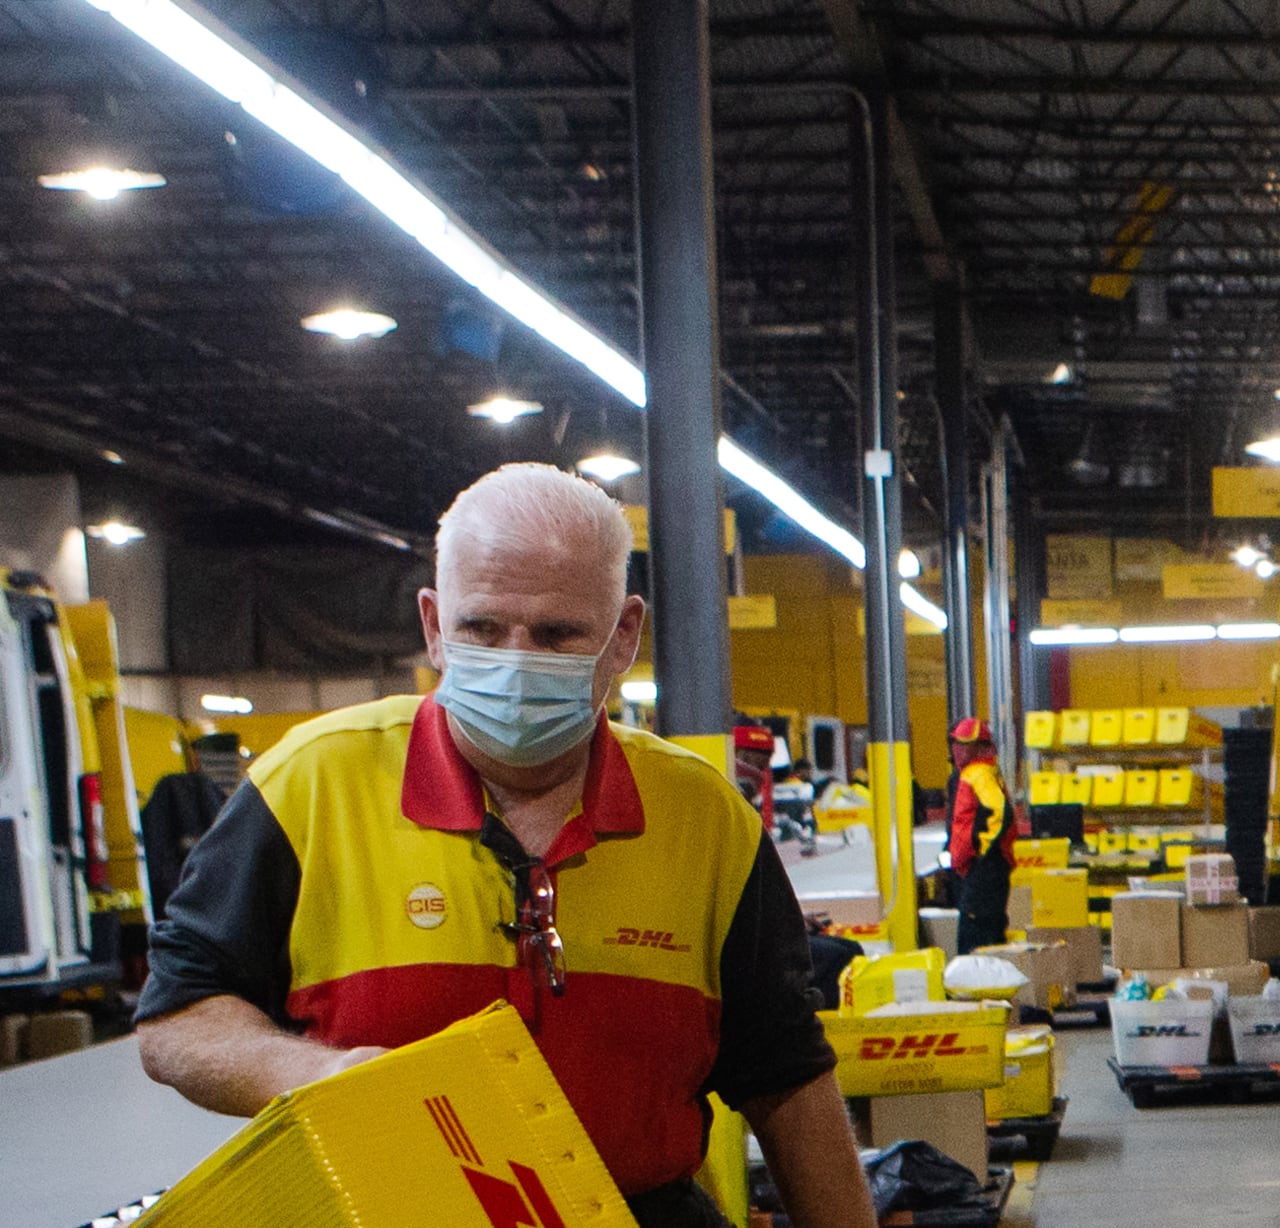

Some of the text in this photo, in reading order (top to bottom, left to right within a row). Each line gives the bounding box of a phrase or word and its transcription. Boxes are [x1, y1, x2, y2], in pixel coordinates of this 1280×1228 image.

[407, 898, 446, 914] CIS
[616, 928, 680, 951] DHL
[860, 1033, 967, 1060] DHL
